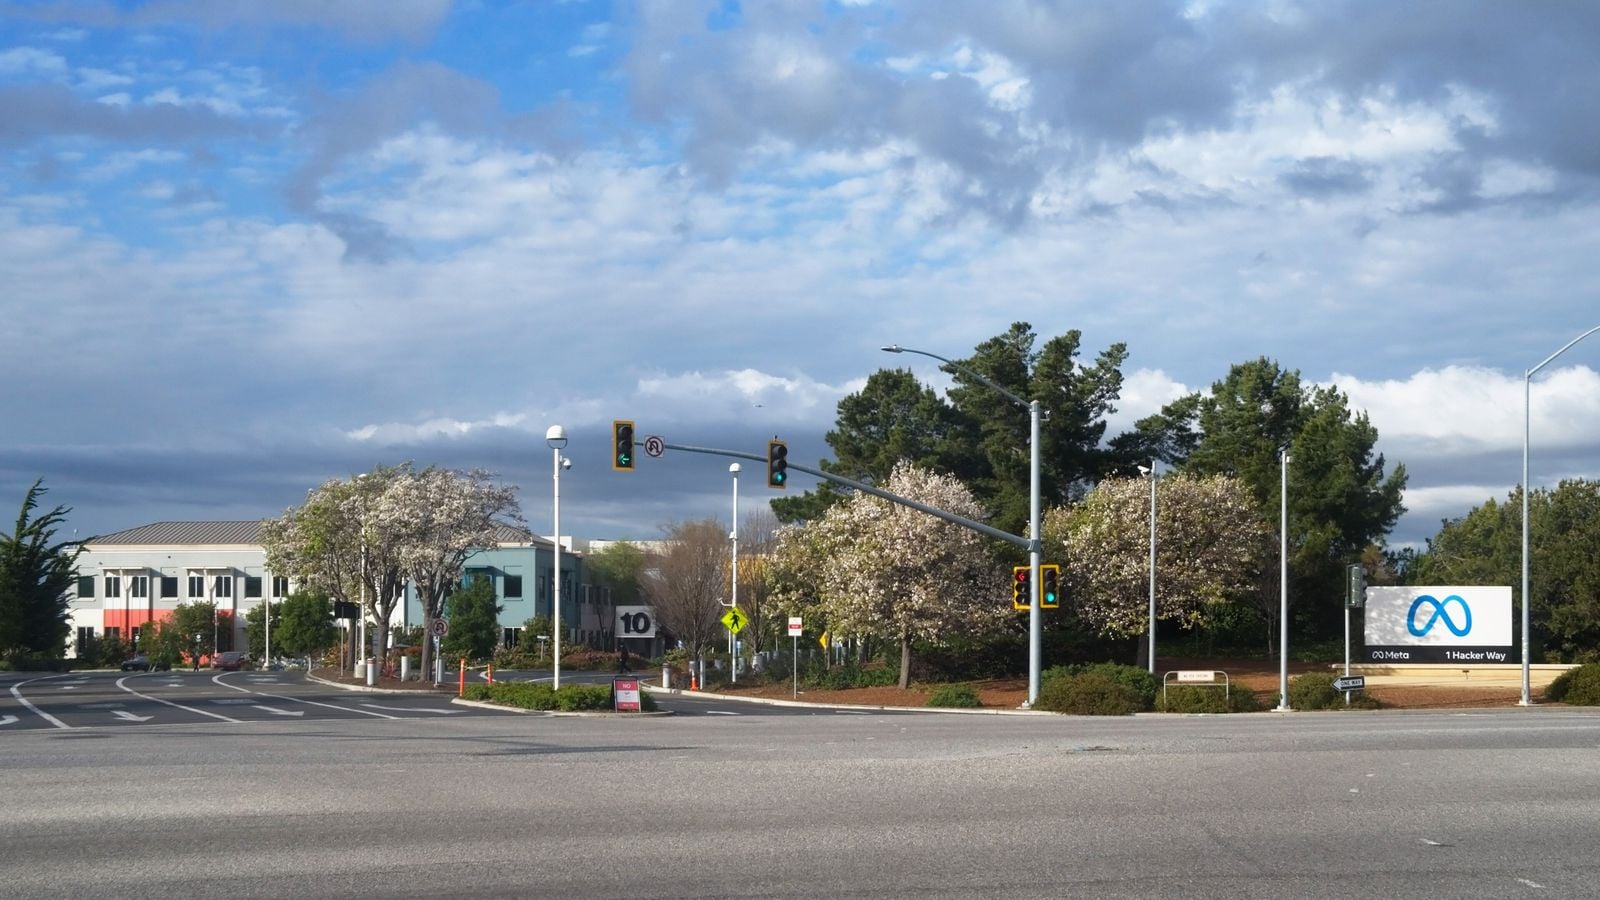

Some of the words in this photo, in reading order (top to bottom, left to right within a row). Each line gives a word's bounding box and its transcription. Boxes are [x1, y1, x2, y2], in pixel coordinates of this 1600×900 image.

[620, 612, 651, 634] 10
[1385, 651, 1410, 660] Meta
[1445, 651, 1450, 659] 1
[1452, 650, 1484, 660] Hacker
[1486, 651, 1506, 662] Way
